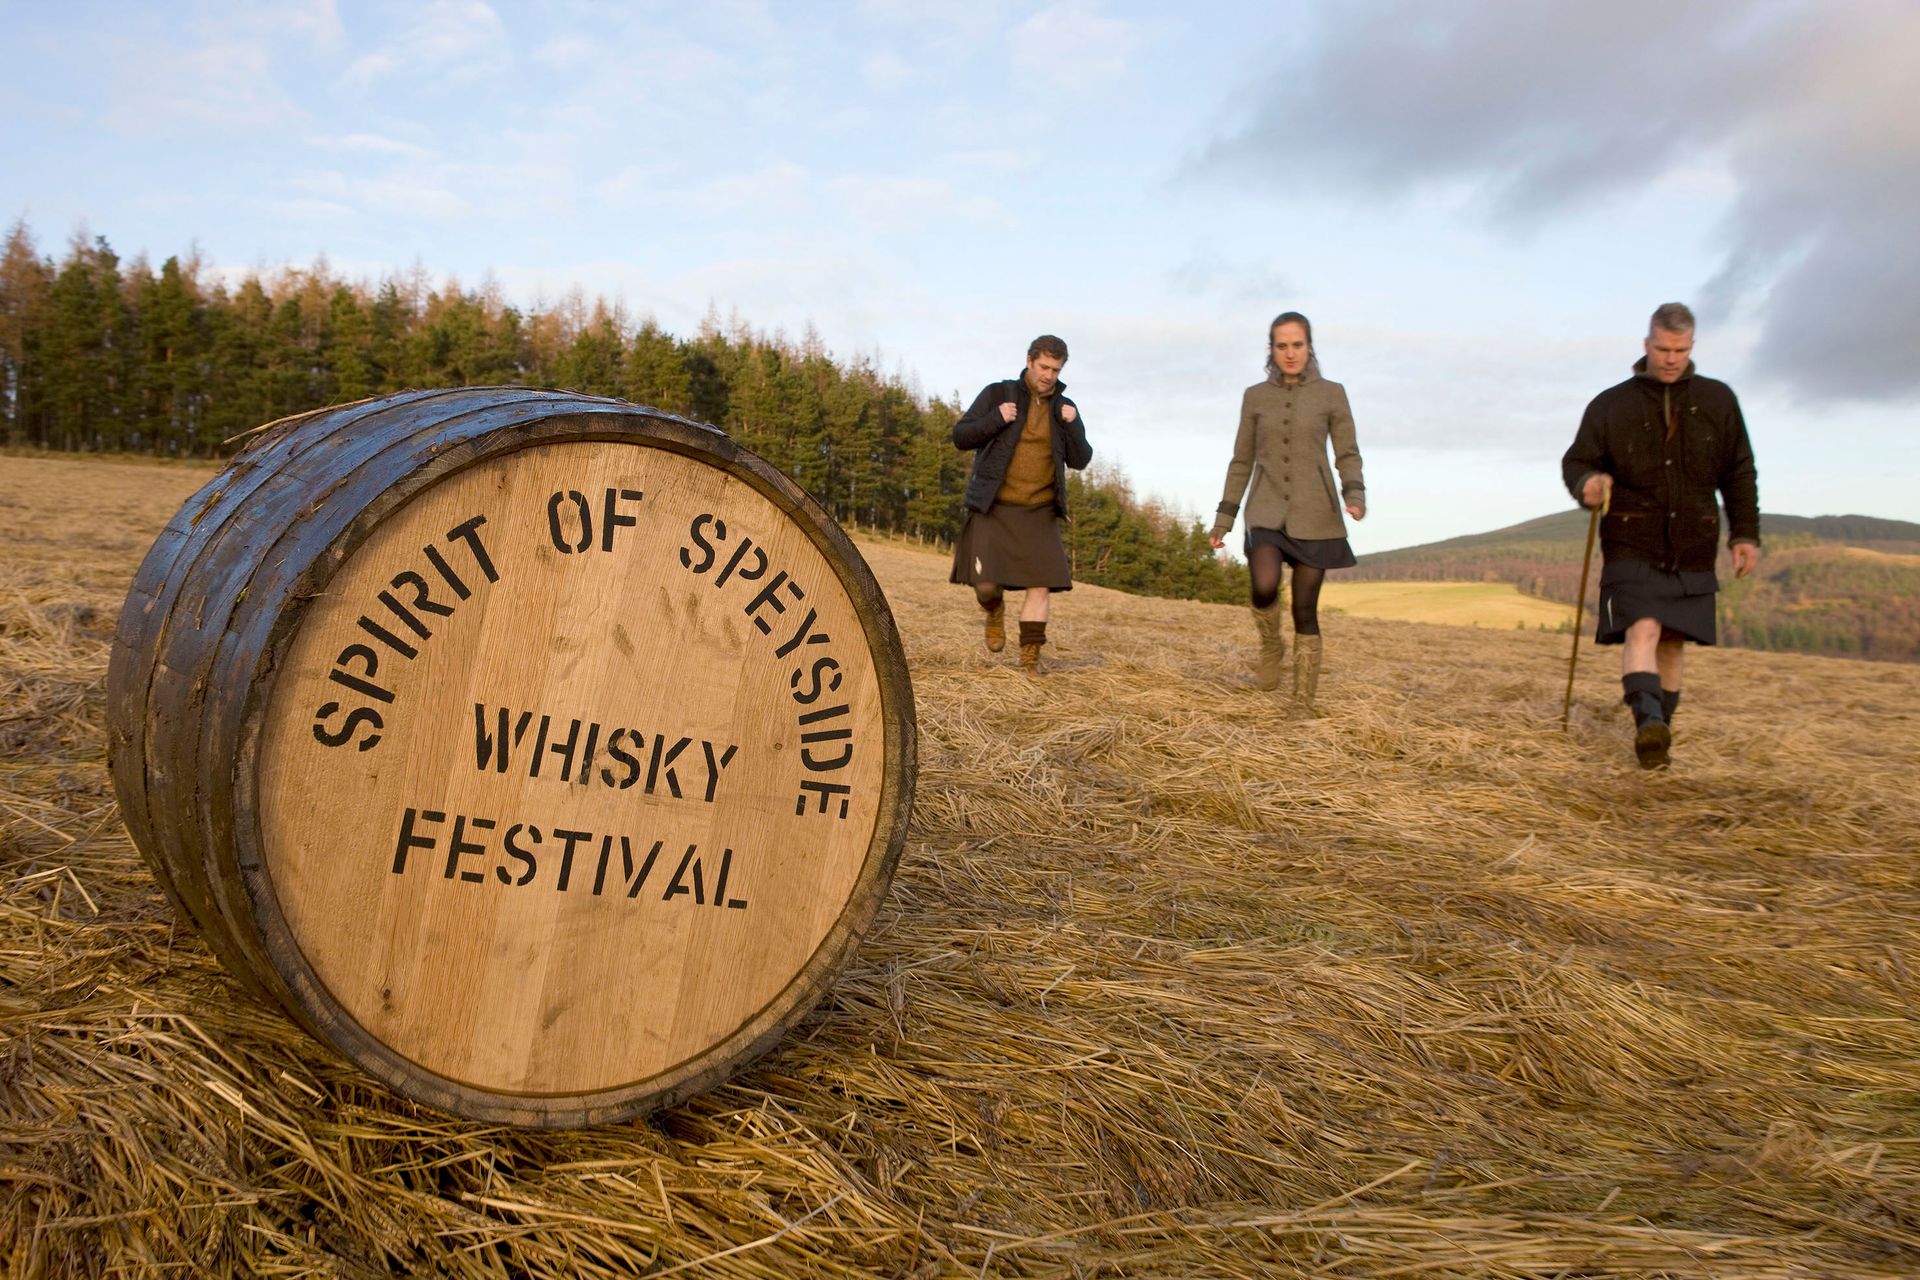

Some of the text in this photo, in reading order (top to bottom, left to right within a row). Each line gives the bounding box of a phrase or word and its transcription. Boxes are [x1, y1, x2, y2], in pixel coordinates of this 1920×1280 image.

[312, 487, 854, 820] SPIRIT OF SPEYSIDE
[474, 702, 739, 803] WHISKY
[391, 807, 748, 911] FESTIVAL
